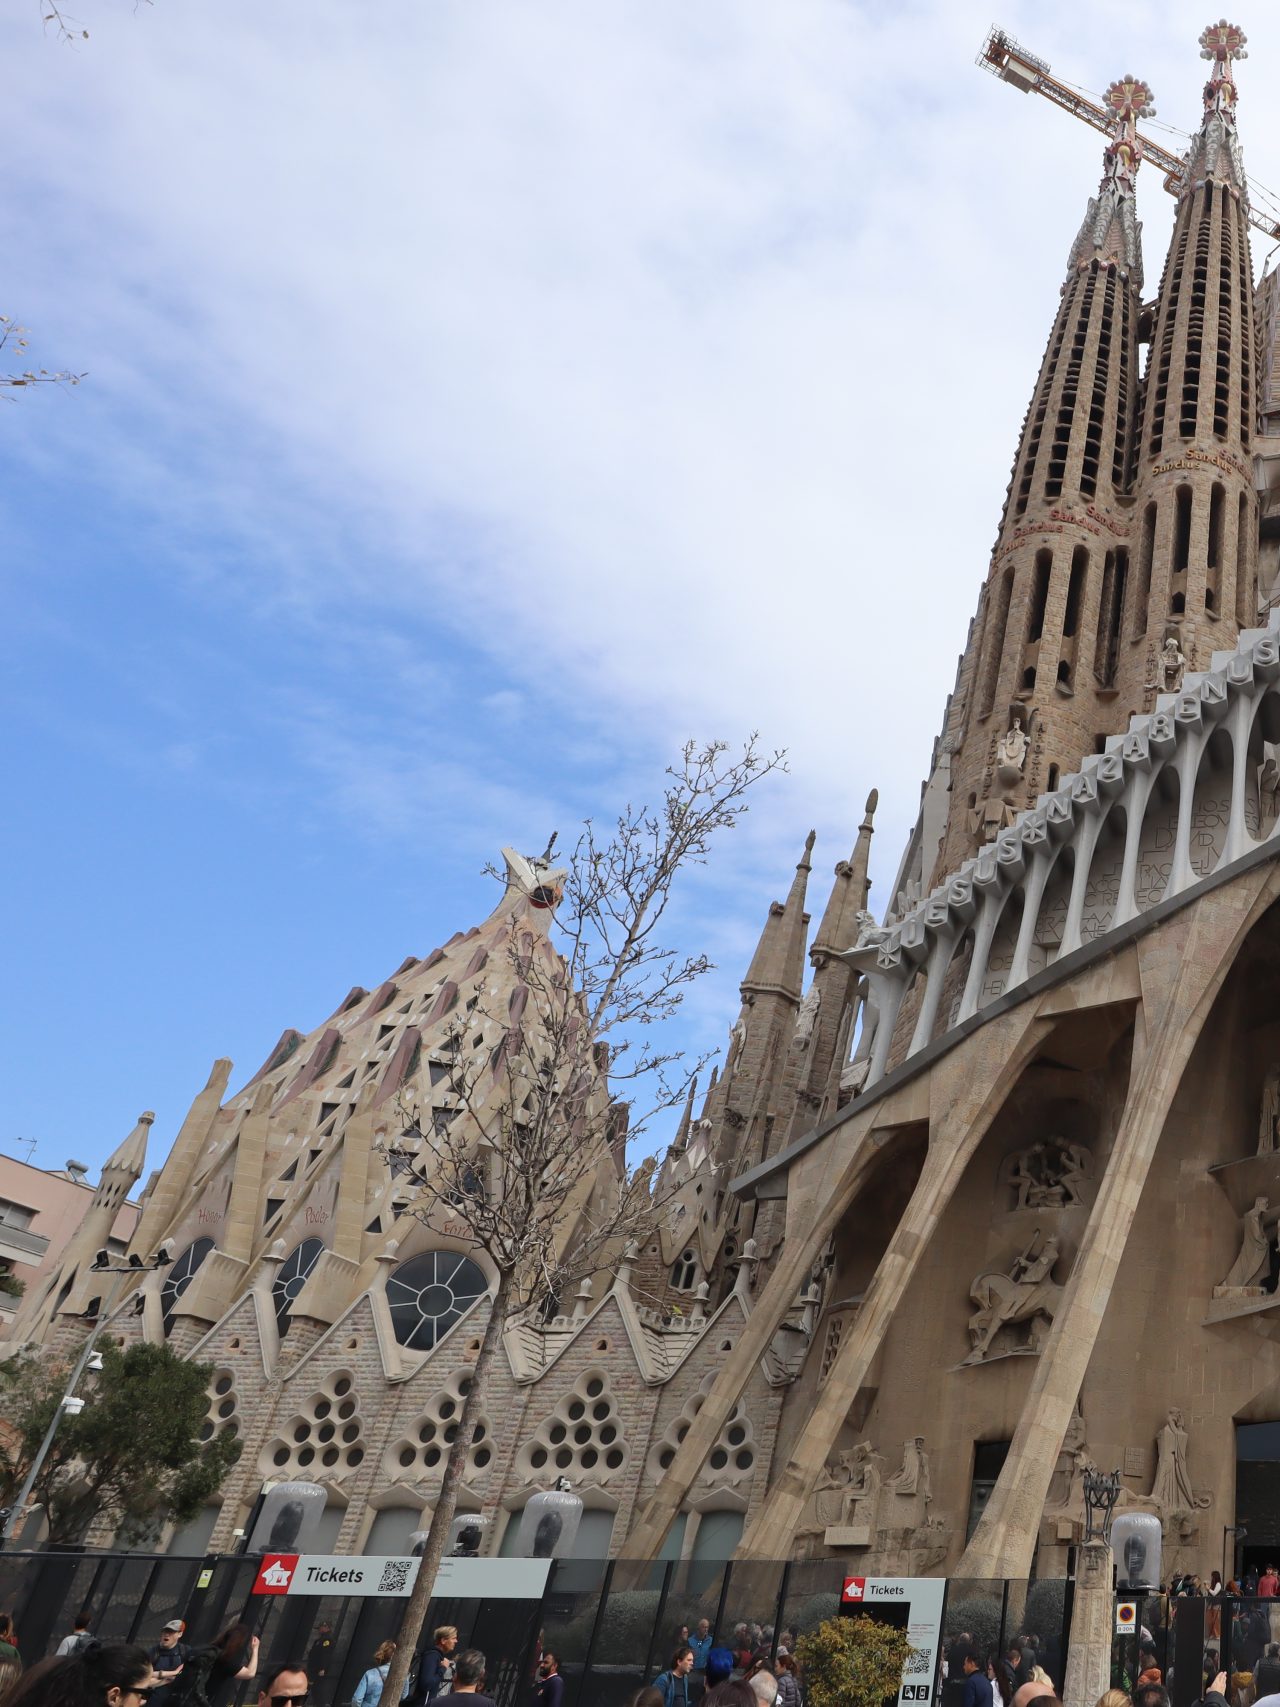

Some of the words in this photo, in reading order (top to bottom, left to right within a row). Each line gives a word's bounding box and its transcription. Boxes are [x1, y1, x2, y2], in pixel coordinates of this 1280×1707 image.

[908, 837, 1017, 944] IESUS
[305, 1566, 365, 1583] Tickets
[869, 1585, 905, 1595] Tickets
